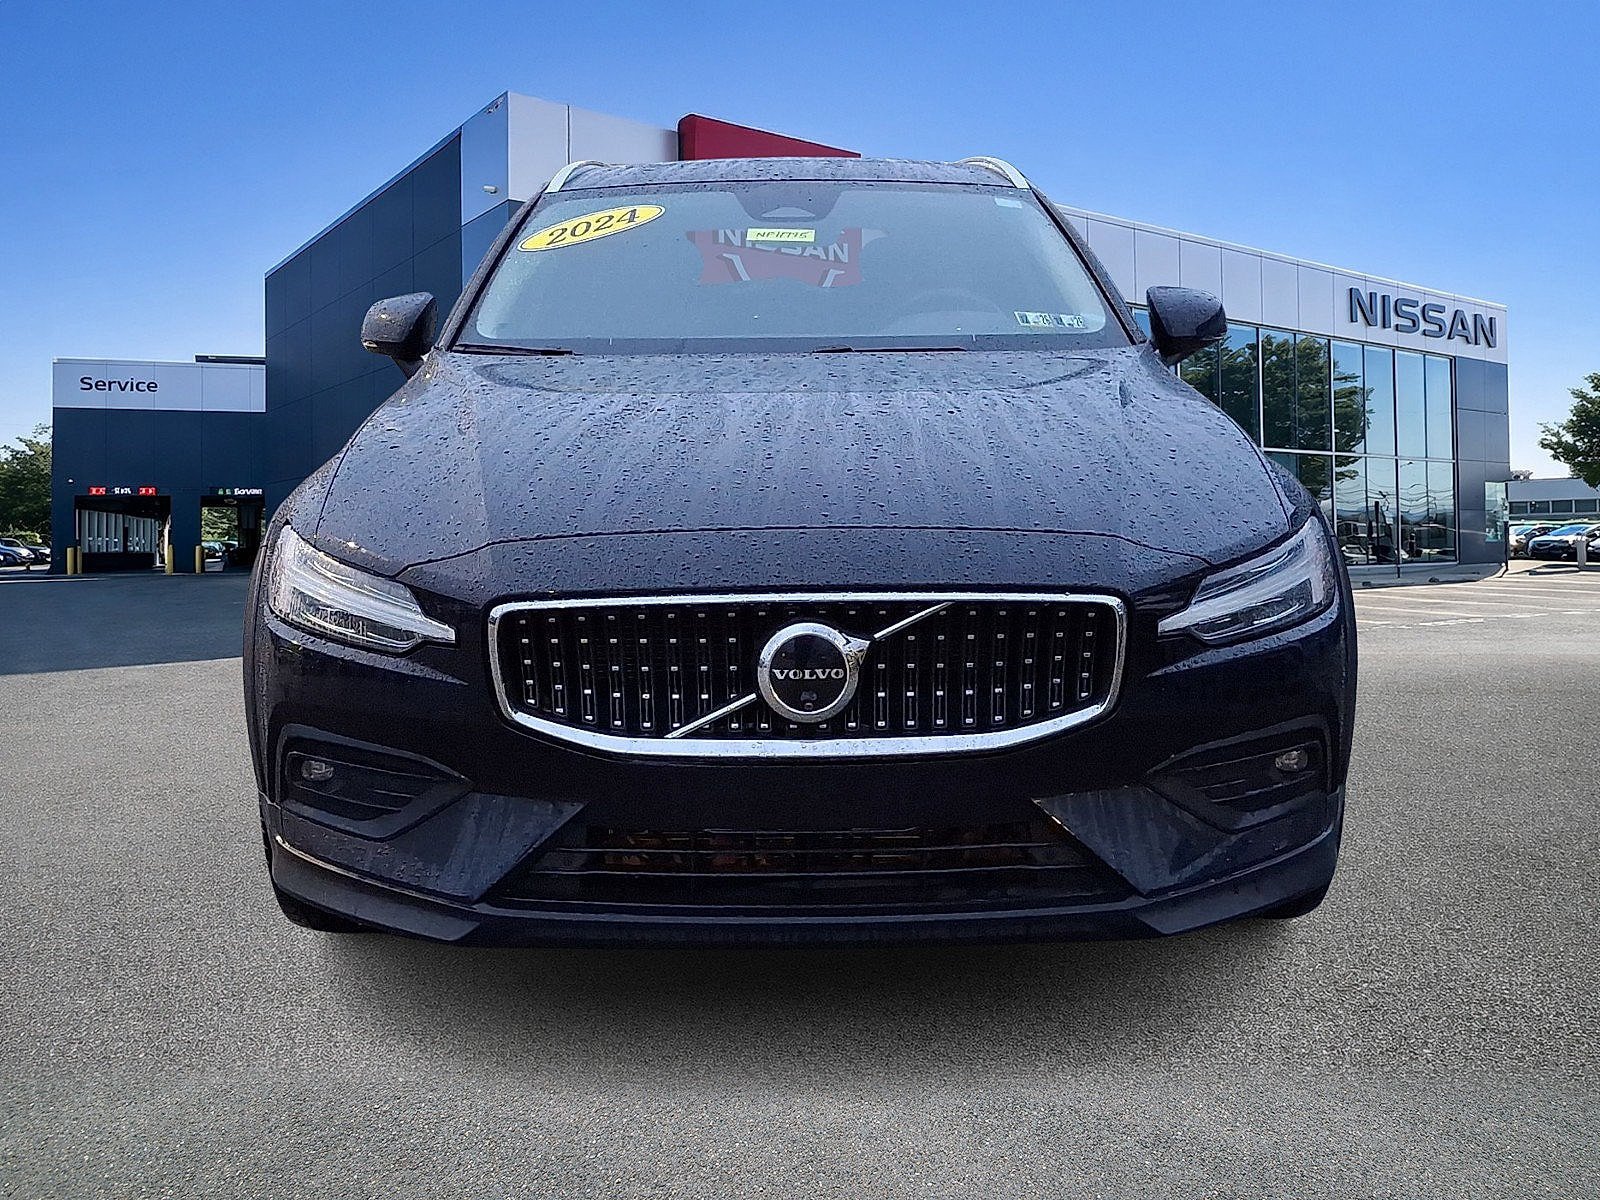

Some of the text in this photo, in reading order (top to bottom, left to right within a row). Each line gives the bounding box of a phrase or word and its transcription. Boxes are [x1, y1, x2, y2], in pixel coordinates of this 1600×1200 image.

[546, 208, 640, 246] 2024
[1348, 287, 1498, 349] NISSAN
[79, 375, 159, 393] Service
[772, 668, 845, 680] VOLVO
